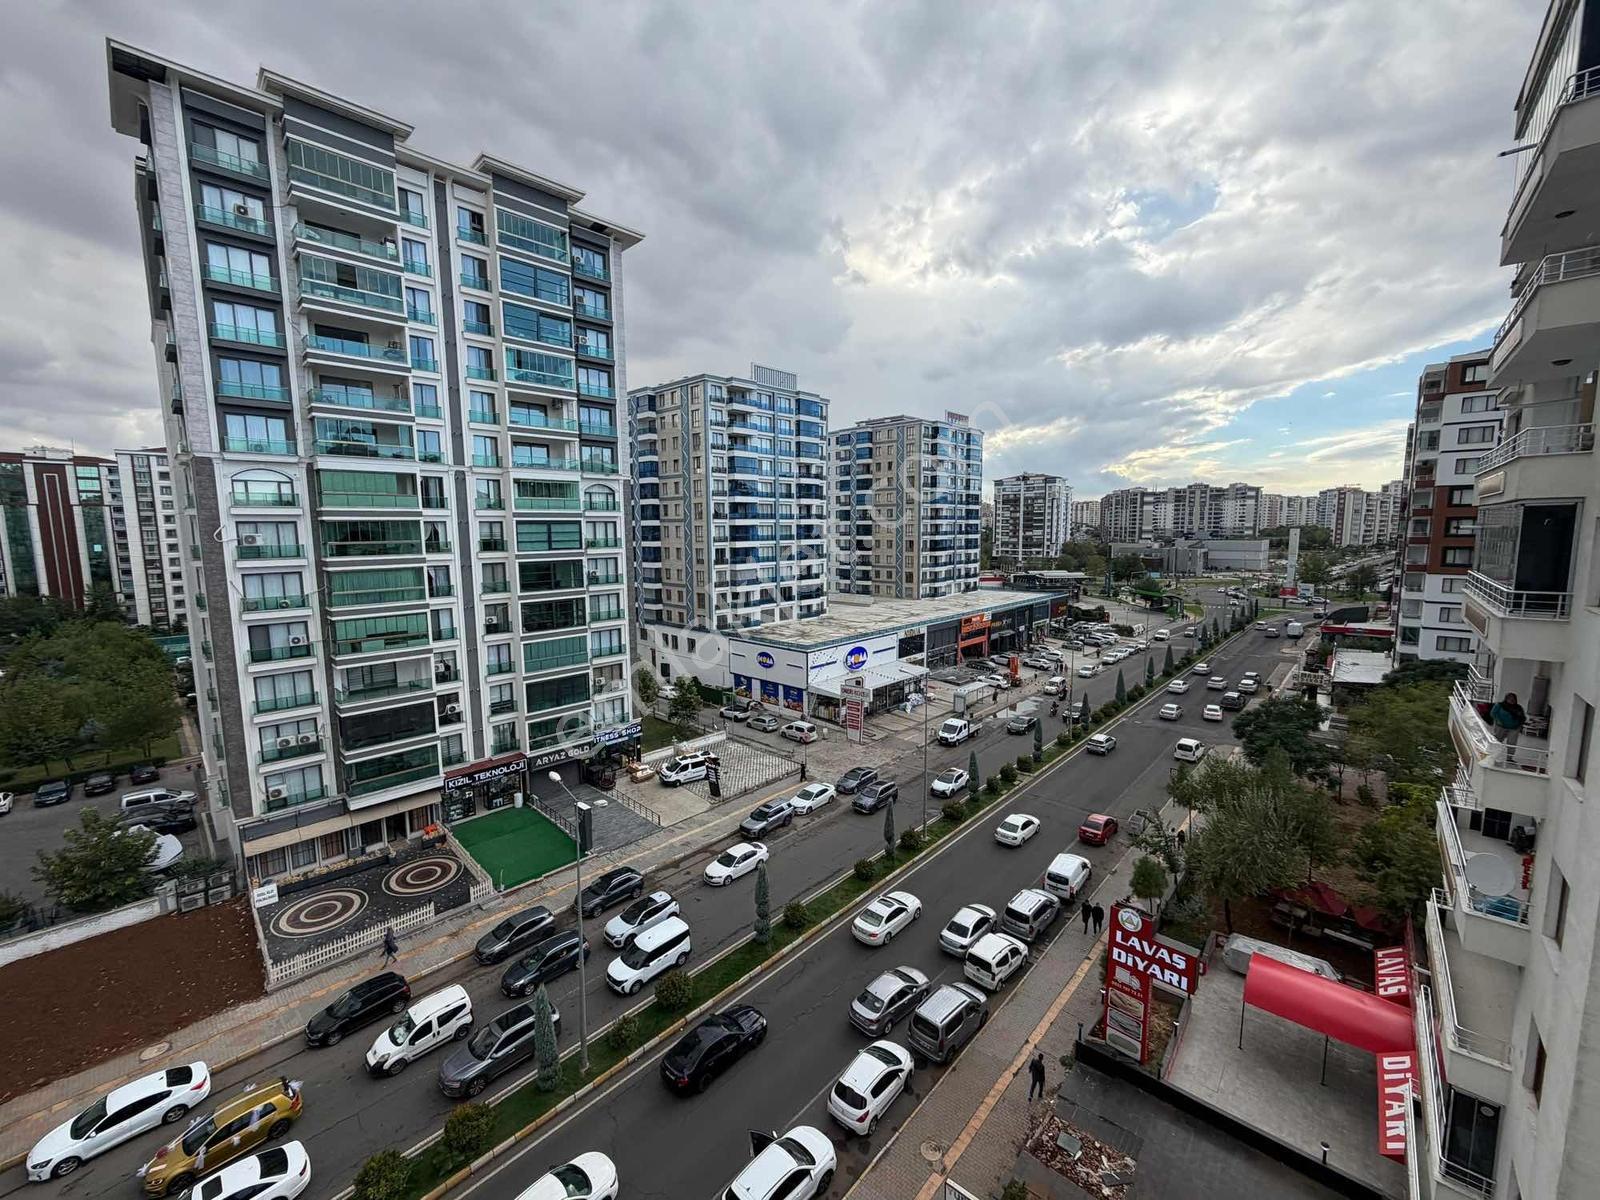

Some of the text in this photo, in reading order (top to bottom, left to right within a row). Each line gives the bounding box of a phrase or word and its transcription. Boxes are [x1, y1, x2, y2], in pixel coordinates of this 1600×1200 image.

[593, 731, 619, 744] ITNESS
[621, 725, 642, 736] SHOP
[535, 745, 590, 767] ARYAZ GOLD
[448, 776, 472, 789] KIZIL
[1115, 930, 1186, 970] LAVAS
[1376, 948, 1407, 997] LAVAS
